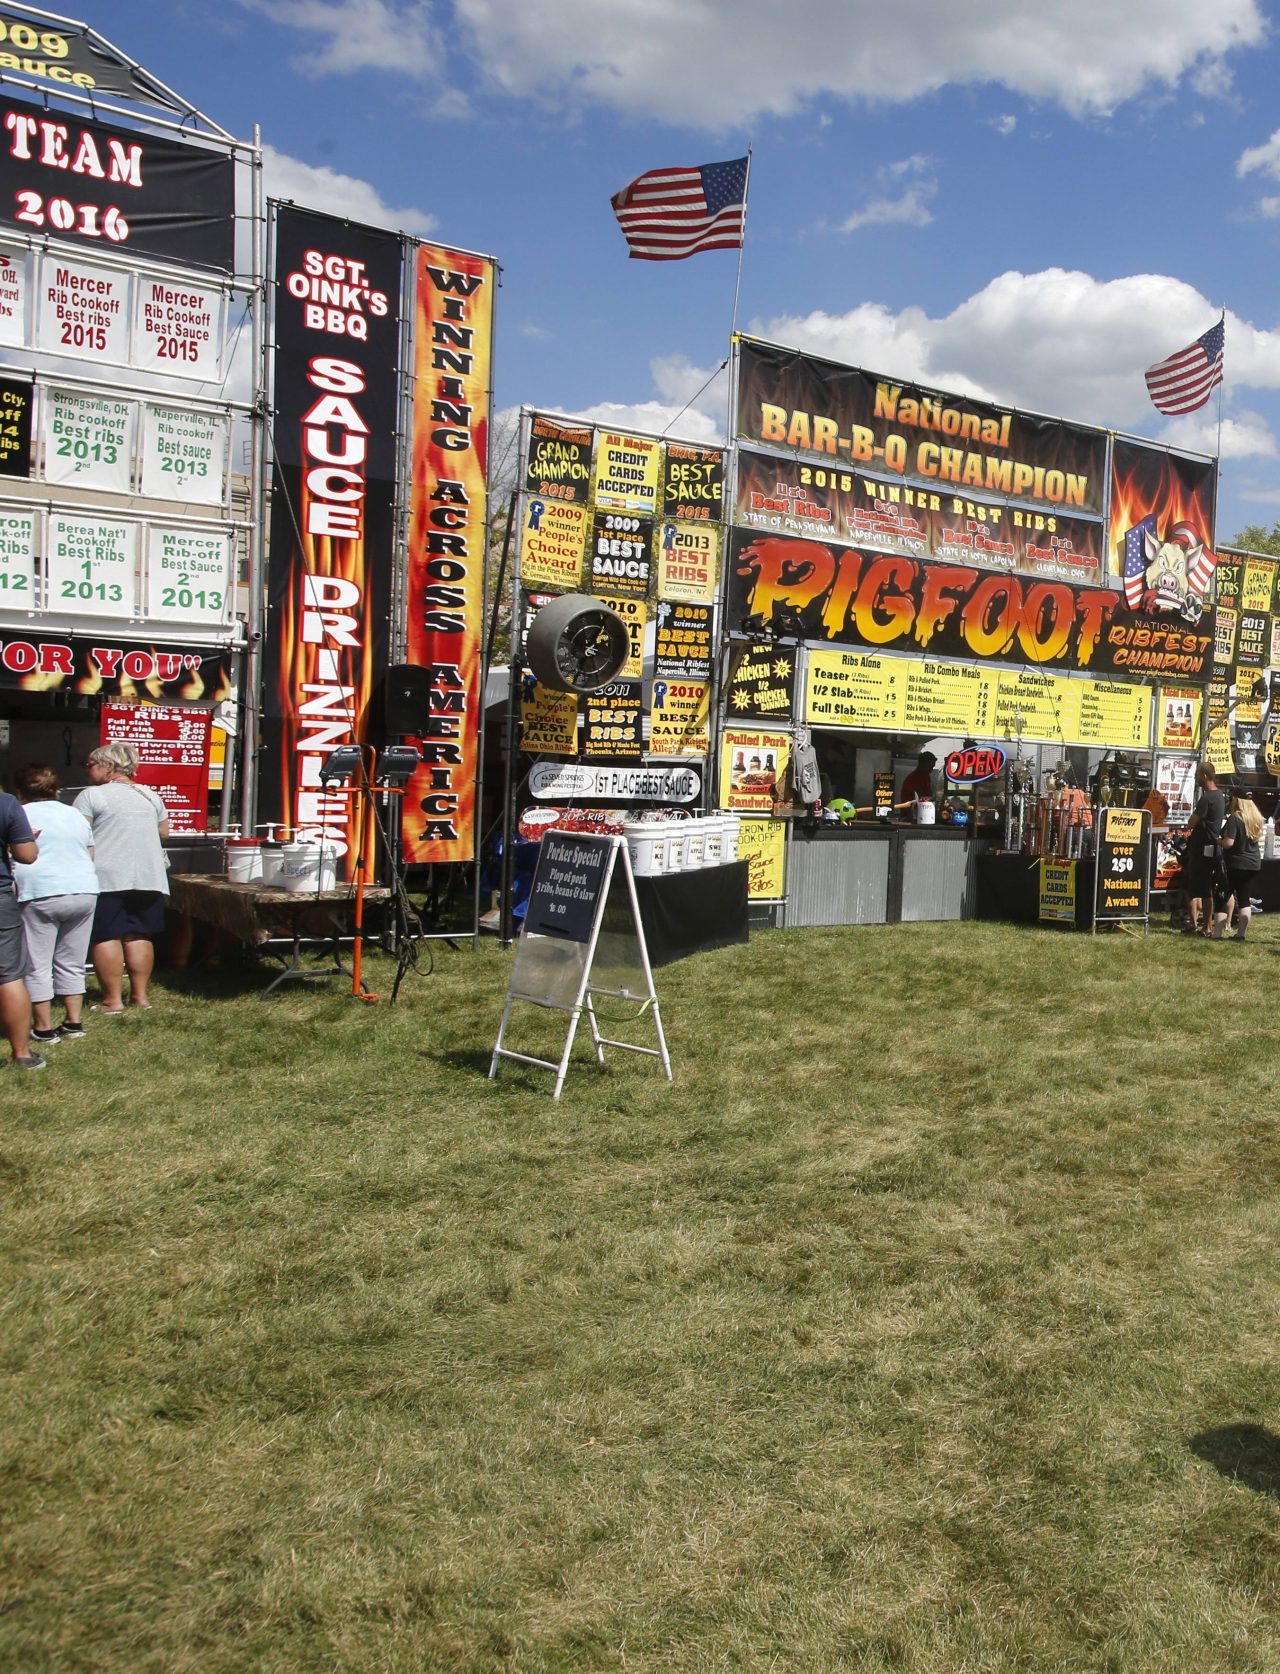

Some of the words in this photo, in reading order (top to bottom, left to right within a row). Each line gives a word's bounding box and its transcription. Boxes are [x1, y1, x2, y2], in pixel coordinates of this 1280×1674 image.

[5, 112, 144, 188] TEAM
[15, 190, 129, 242] 2016
[304, 250, 369, 288] SGT.
[56, 268, 112, 295] Mercer
[48, 288, 67, 304] Rib
[72, 292, 119, 314] Cookoff
[152, 284, 204, 309] Mercer
[288, 272, 389, 317] OINK'S
[56, 305, 84, 323] Best
[88, 311, 111, 327] ribs
[144, 304, 163, 319] Rib
[167, 308, 210, 327] Cookoff
[305, 303, 368, 342] BBQ
[61, 322, 106, 350] 2015
[146, 319, 172, 334] Best
[175, 323, 209, 341] Sauce
[157, 335, 198, 362] 2015
[426, 264, 485, 452] WINNING
[55, 407, 75, 423] Rib
[79, 412, 126, 430] cookoff
[873, 382, 1012, 448] National
[53, 420, 90, 439] Best
[95, 429, 124, 445] ribs
[158, 423, 174, 434] Rib
[177, 427, 215, 441] cookoff
[56, 437, 117, 465] 2013
[158, 437, 182, 454] Best
[183, 442, 212, 460] sauce
[302, 356, 371, 540] SAUCE
[536, 442, 579, 461] GRAND
[761, 402, 907, 475] BAR-B-Q
[917, 441, 1087, 506] CHAMPION
[161, 457, 207, 477] 2013
[608, 450, 648, 467] CREDIT
[528, 460, 589, 480] CHAMPION
[609, 465, 645, 481] CARDS
[670, 464, 716, 481] BEST
[539, 481, 575, 500] 2015
[597, 479, 654, 498] ACCEPTED
[666, 482, 722, 501] SAUCE
[751, 492, 790, 514] Best
[793, 499, 831, 522] Ribs
[801, 467, 852, 493] 2015
[864, 480, 941, 512] WINNER
[953, 498, 1001, 524] BEST
[1014, 511, 1056, 533] RIBS
[548, 506, 583, 522] 2009
[58, 522, 94, 536] Berea
[99, 526, 126, 539] Nat'l
[548, 520, 580, 533] winner
[605, 516, 640, 532] 2009
[67, 534, 116, 548] Cookoff
[163, 534, 223, 549] Mercer
[527, 539, 578, 558] Choice
[597, 538, 645, 556] BEST
[675, 533, 709, 549] 2013
[942, 528, 973, 547] Best
[975, 535, 1014, 555] Sauce
[57, 543, 91, 559] Best
[95, 547, 125, 563] Ribs
[164, 546, 221, 560] Rib-off
[423, 478, 471, 635] ACROSS
[526, 551, 576, 571] Award
[665, 548, 710, 566] BEST
[1026, 543, 1056, 562] Best
[1057, 549, 1098, 568] Sauce
[161, 558, 186, 571] Best
[190, 560, 223, 573] Sauce
[592, 558, 649, 579] SAUCE
[666, 565, 708, 583] RIBS
[1216, 566, 1239, 582] BEST
[61, 580, 123, 601] 2013
[161, 588, 223, 611] 2013
[737, 538, 1120, 667] PIGFOOT
[675, 607, 708, 620] 2010
[1134, 619, 1192, 635] NATIONAL
[1242, 617, 1265, 630] 2013
[657, 629, 710, 643] BEST
[1107, 625, 1212, 653] RIBFEST
[1241, 629, 1263, 642] BEST
[657, 643, 709, 659] SAUCE
[1239, 641, 1264, 653] SAUCE
[842, 654, 859, 667] Ribs
[860, 657, 881, 669] Alone
[1112, 649, 1204, 673] CHAMPION
[924, 663, 935, 674] Rib
[937, 665, 959, 676] Combo
[961, 668, 980, 679] Meals
[1018, 674, 1055, 687] Sandwiches
[1094, 682, 1132, 695] Miscellaneous
[670, 686, 704, 698] 2010
[587, 698, 608, 706] 2nd
[611, 698, 641, 708] place
[670, 701, 700, 709] winner
[135, 711, 182, 721] Ribs
[525, 713, 569, 724] Choice
[589, 709, 638, 723] BEST
[659, 714, 699, 722] BEST
[590, 726, 635, 740] RIBS
[652, 727, 705, 735] SAUCE
[726, 732, 759, 747] Pulled
[762, 736, 786, 747] Pork
[419, 662, 468, 842] AMERICA
[1236, 740, 1261, 750] twitter
[947, 751, 1002, 778] OPEN
[546, 843, 572, 863] Porker
[572, 846, 602, 868] Special
[1112, 845, 1134, 856] over
[1111, 858, 1134, 873] 250
[550, 868, 564, 881] Plop
[564, 872, 570, 882] of
[570, 872, 587, 886] pork
[1104, 878, 1141, 890] National
[1046, 881, 1067, 894] CARDS
[1040, 894, 1074, 907] ACCEPTED
[1105, 895, 1139, 908] Awards
